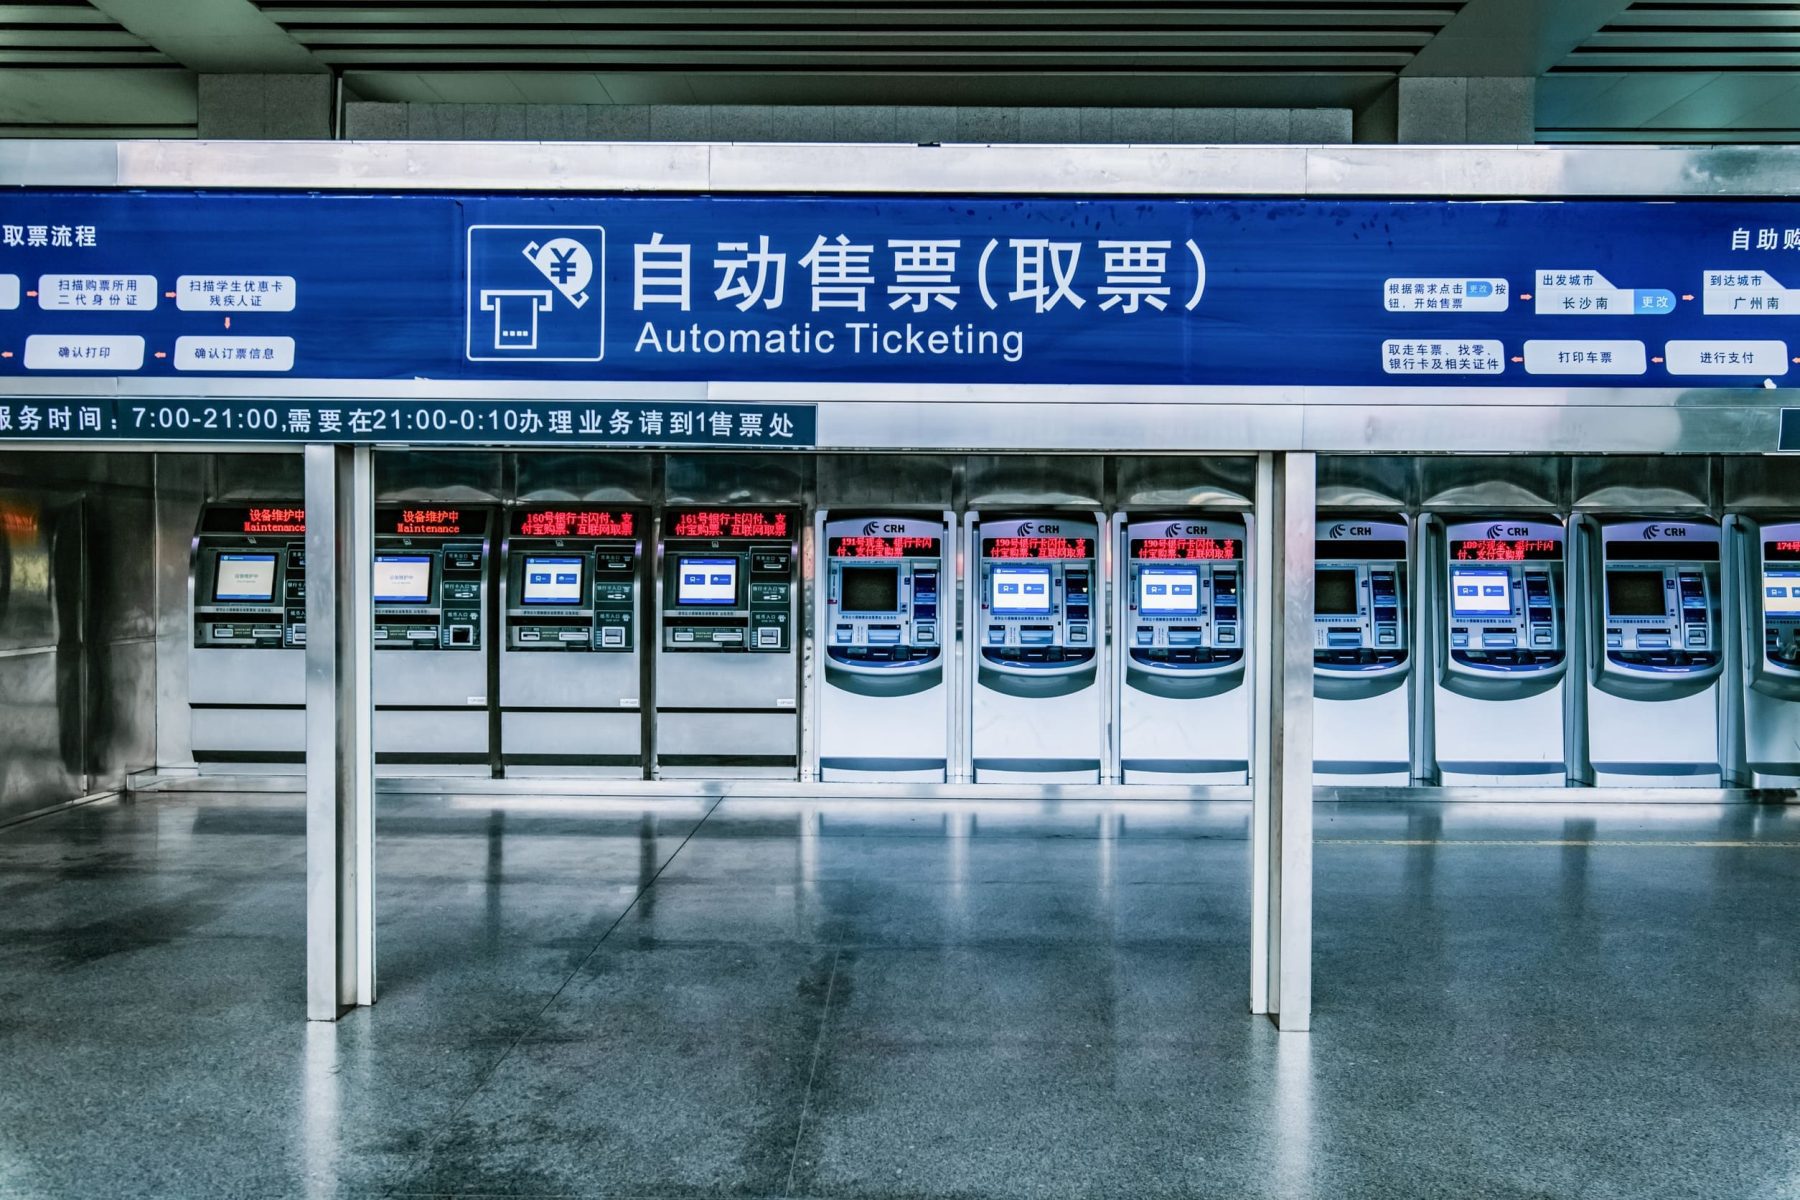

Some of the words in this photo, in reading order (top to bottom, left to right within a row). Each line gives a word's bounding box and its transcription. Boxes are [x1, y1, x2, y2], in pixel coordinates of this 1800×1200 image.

[2, 224, 97, 248] 取票流程
[632, 231, 1207, 314] 自动售票(取票)
[58, 279, 137, 292] 扫描购票所用
[189, 279, 283, 293] 扫描学生优惠卡
[1542, 274, 1594, 287] 出发城市
[1710, 274, 1762, 287] 到达城市
[58, 293, 138, 306] 二代身份证
[209, 294, 262, 307] 残疾人证
[1562, 296, 1609, 310] 长沙南
[1641, 295, 1669, 309] 更改
[1733, 296, 1779, 310] 广州南
[634, 321, 835, 354] Automatic
[845, 322, 1024, 362] Ticketing
[58, 346, 111, 359] 确认打印
[194, 347, 275, 360] 确认订票信息
[1558, 351, 1612, 364] 打印车票
[1699, 351, 1755, 364] 进行支付
[1388, 358, 1499, 370] 银行卡及相关证件
[249, 508, 305, 522] 设备维护中
[402, 510, 459, 523] 设备维护中
[243, 521, 306, 532] Maintenance
[396, 522, 460, 533] Maintenance
[883, 524, 905, 534] CRH
[1037, 525, 1060, 535] CRH
[1185, 526, 1208, 536] CRH
[1349, 526, 1372, 536] CRH
[1506, 527, 1529, 537] CRH
[1663, 527, 1686, 537] CRH
